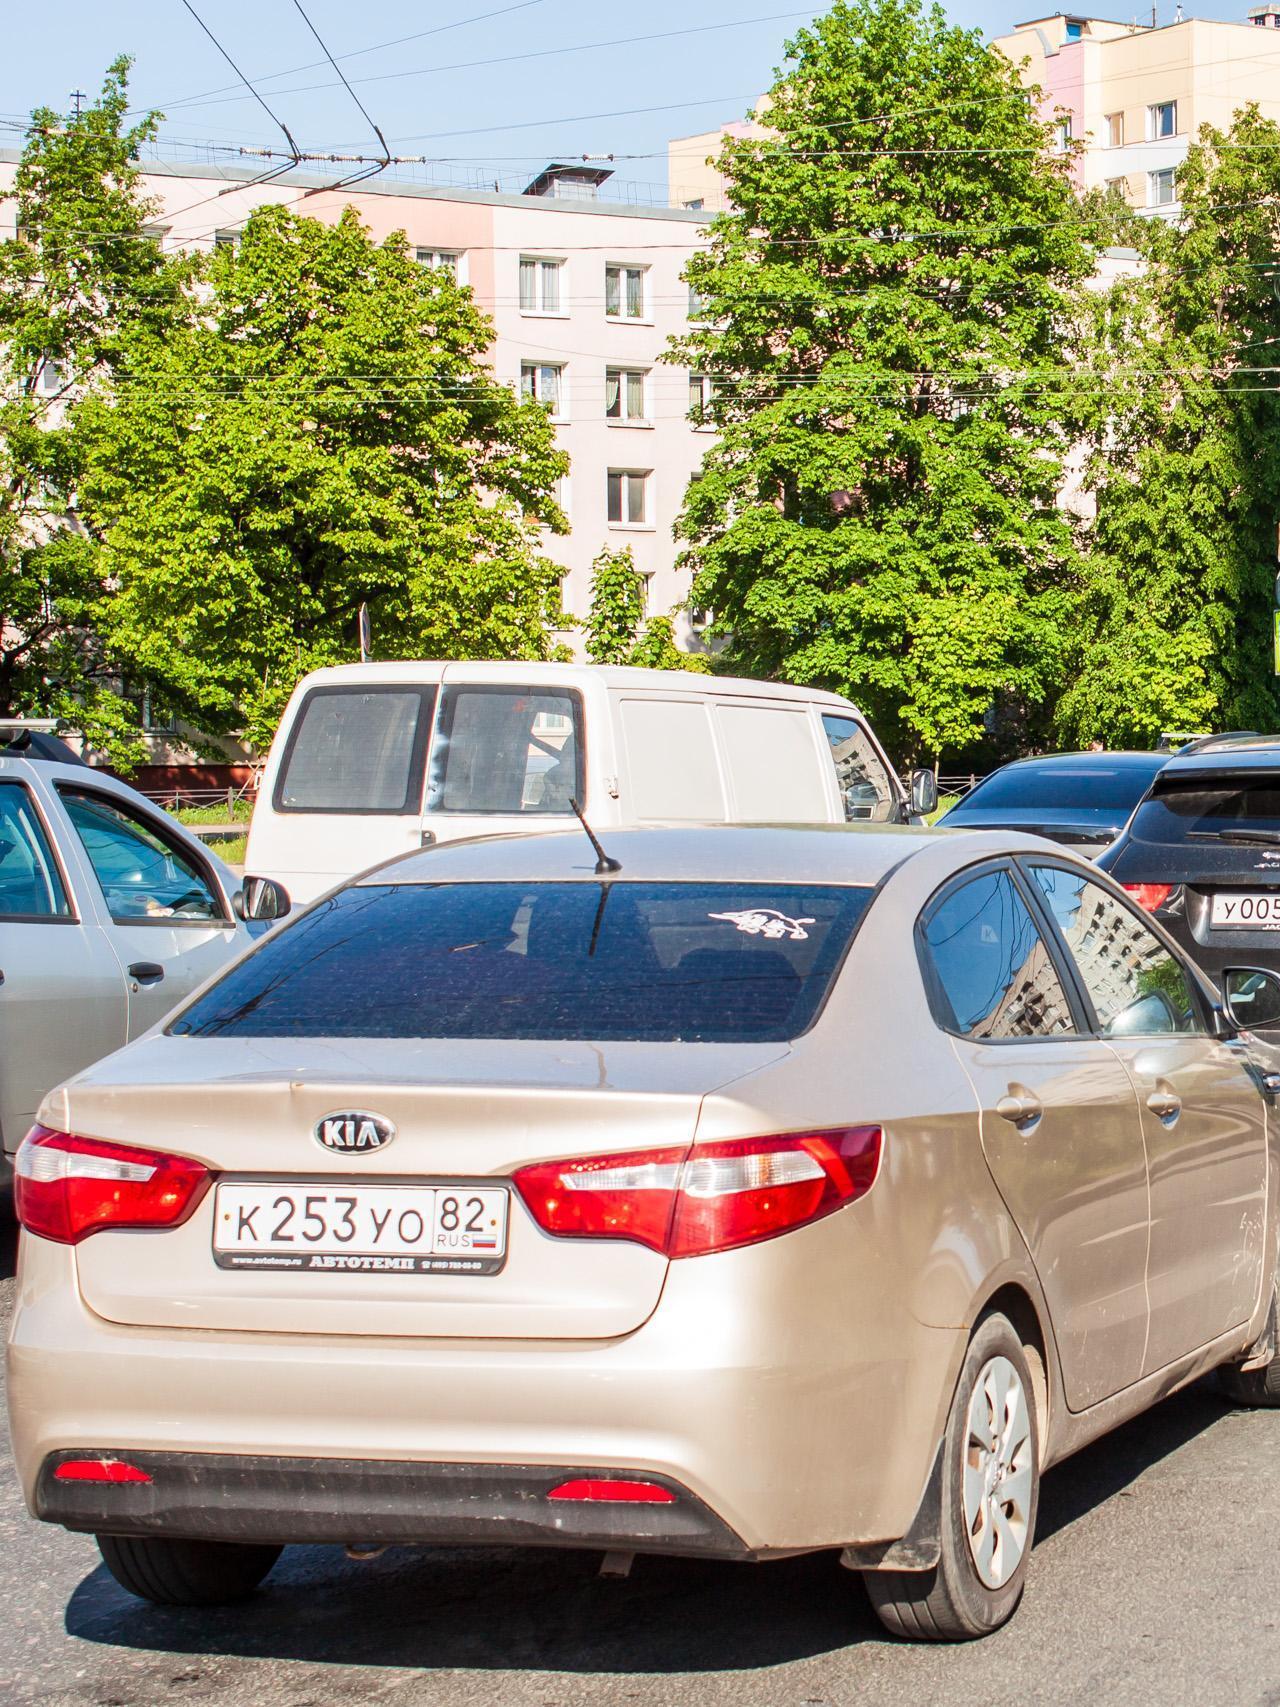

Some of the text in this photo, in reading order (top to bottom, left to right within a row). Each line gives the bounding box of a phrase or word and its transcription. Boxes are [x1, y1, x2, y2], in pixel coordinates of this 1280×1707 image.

[324, 1120, 380, 1146] KIA
[237, 1196, 484, 1244] К253УО 82
[436, 1234, 470, 1248] RUS
[309, 1255, 416, 1270] АВТОТЕМП
